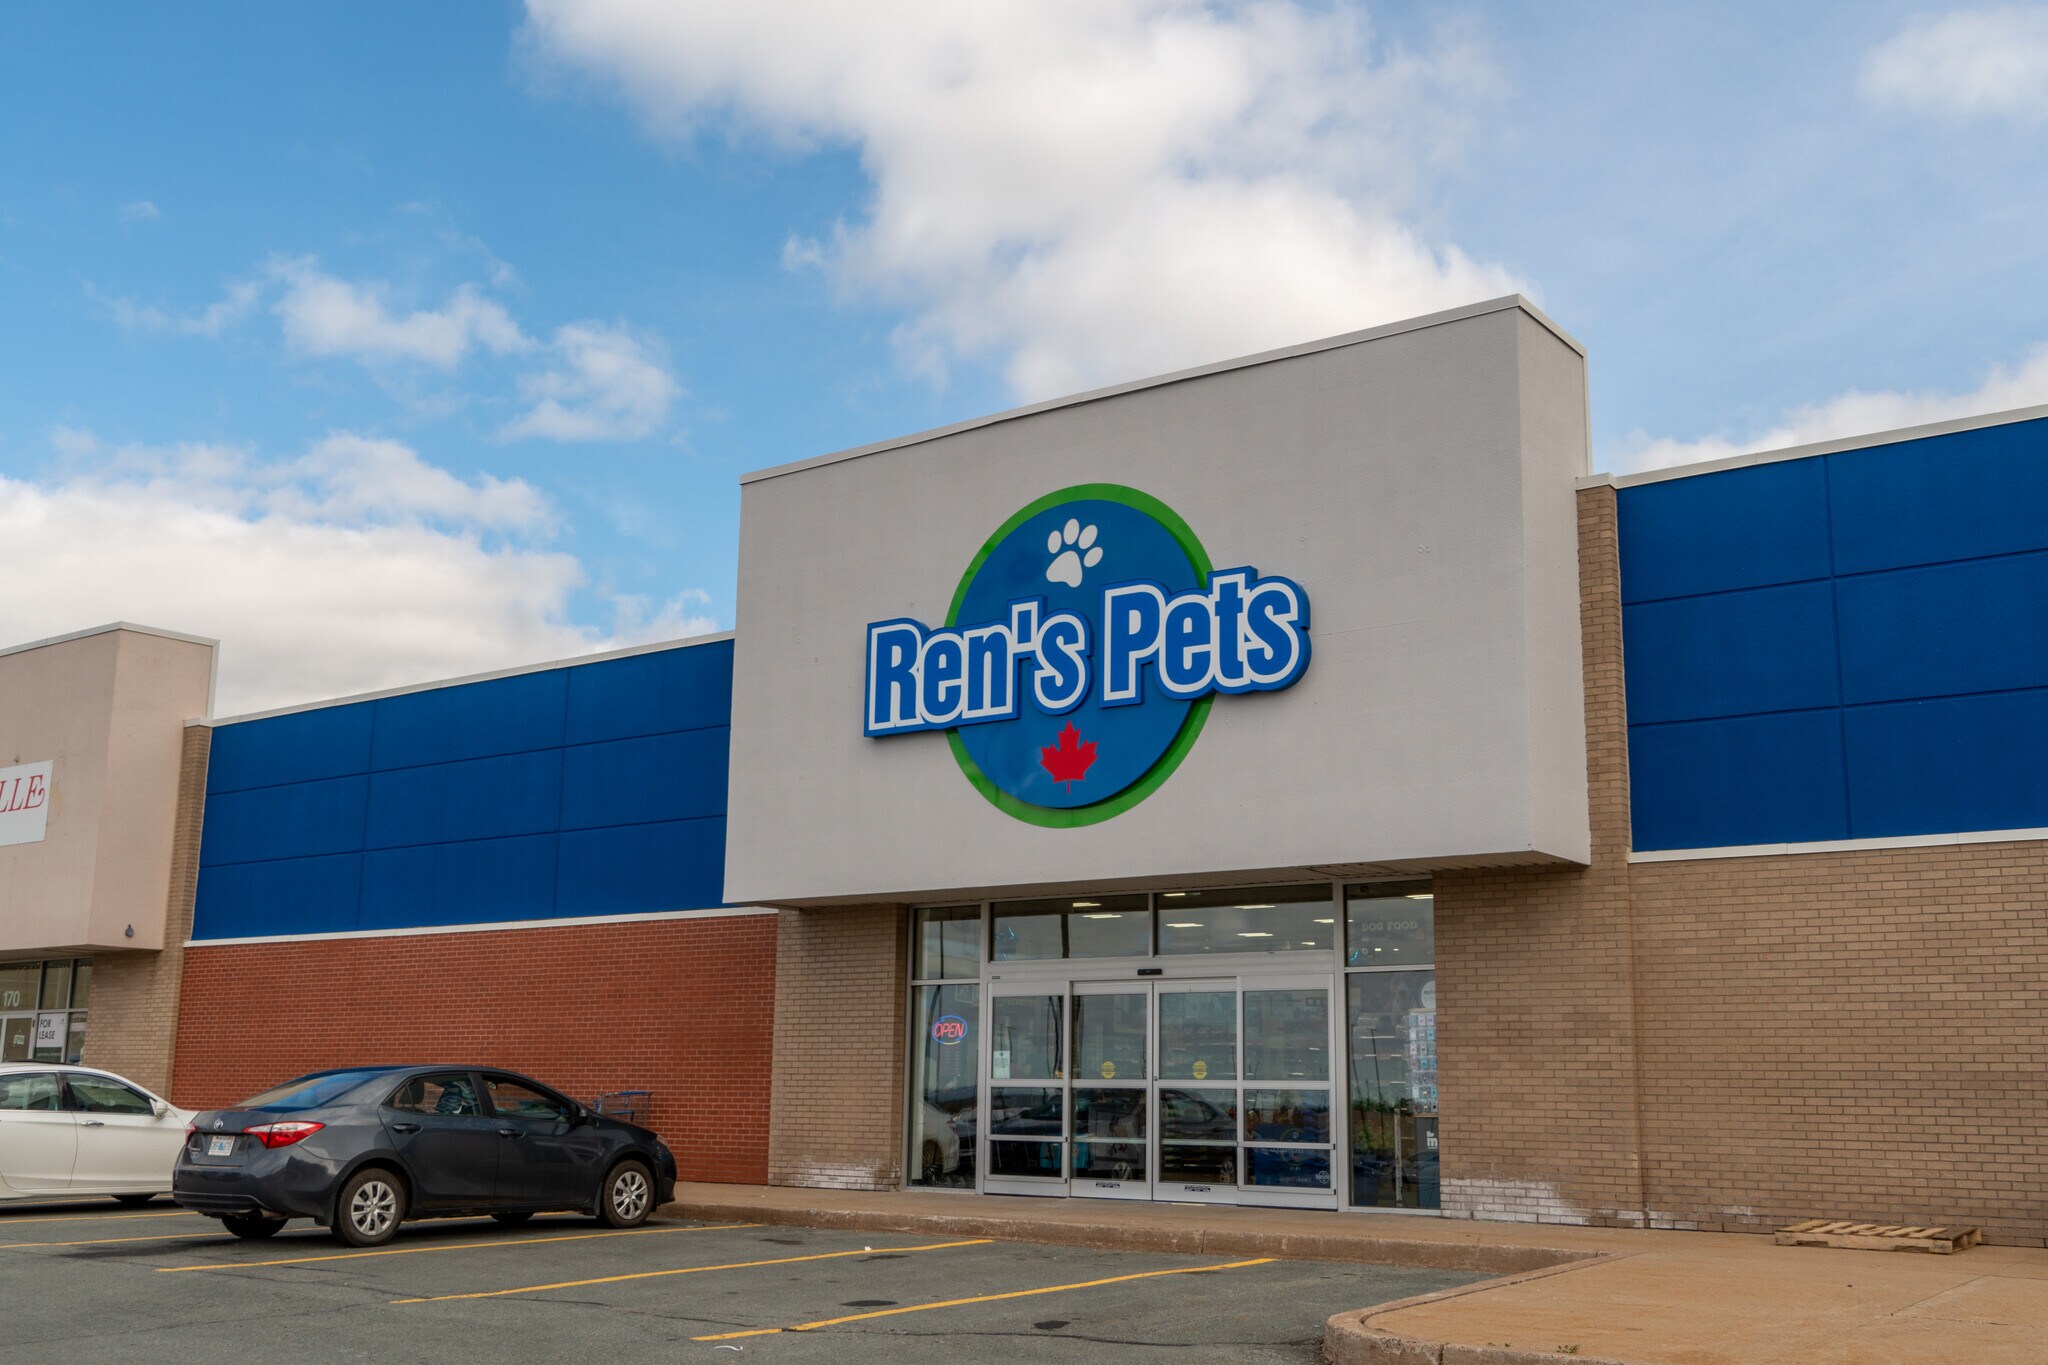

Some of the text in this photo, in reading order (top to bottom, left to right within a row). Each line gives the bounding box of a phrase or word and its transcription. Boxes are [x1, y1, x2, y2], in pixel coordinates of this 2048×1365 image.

[867, 571, 1301, 732] Ren's Pets
[1361, 920, 1418, 932] DOG FOOD
[3, 990, 20, 1007] 170
[40, 1019, 51, 1028] FOR
[933, 1022, 965, 1038] OPEN
[39, 1030, 55, 1040] LEASE
